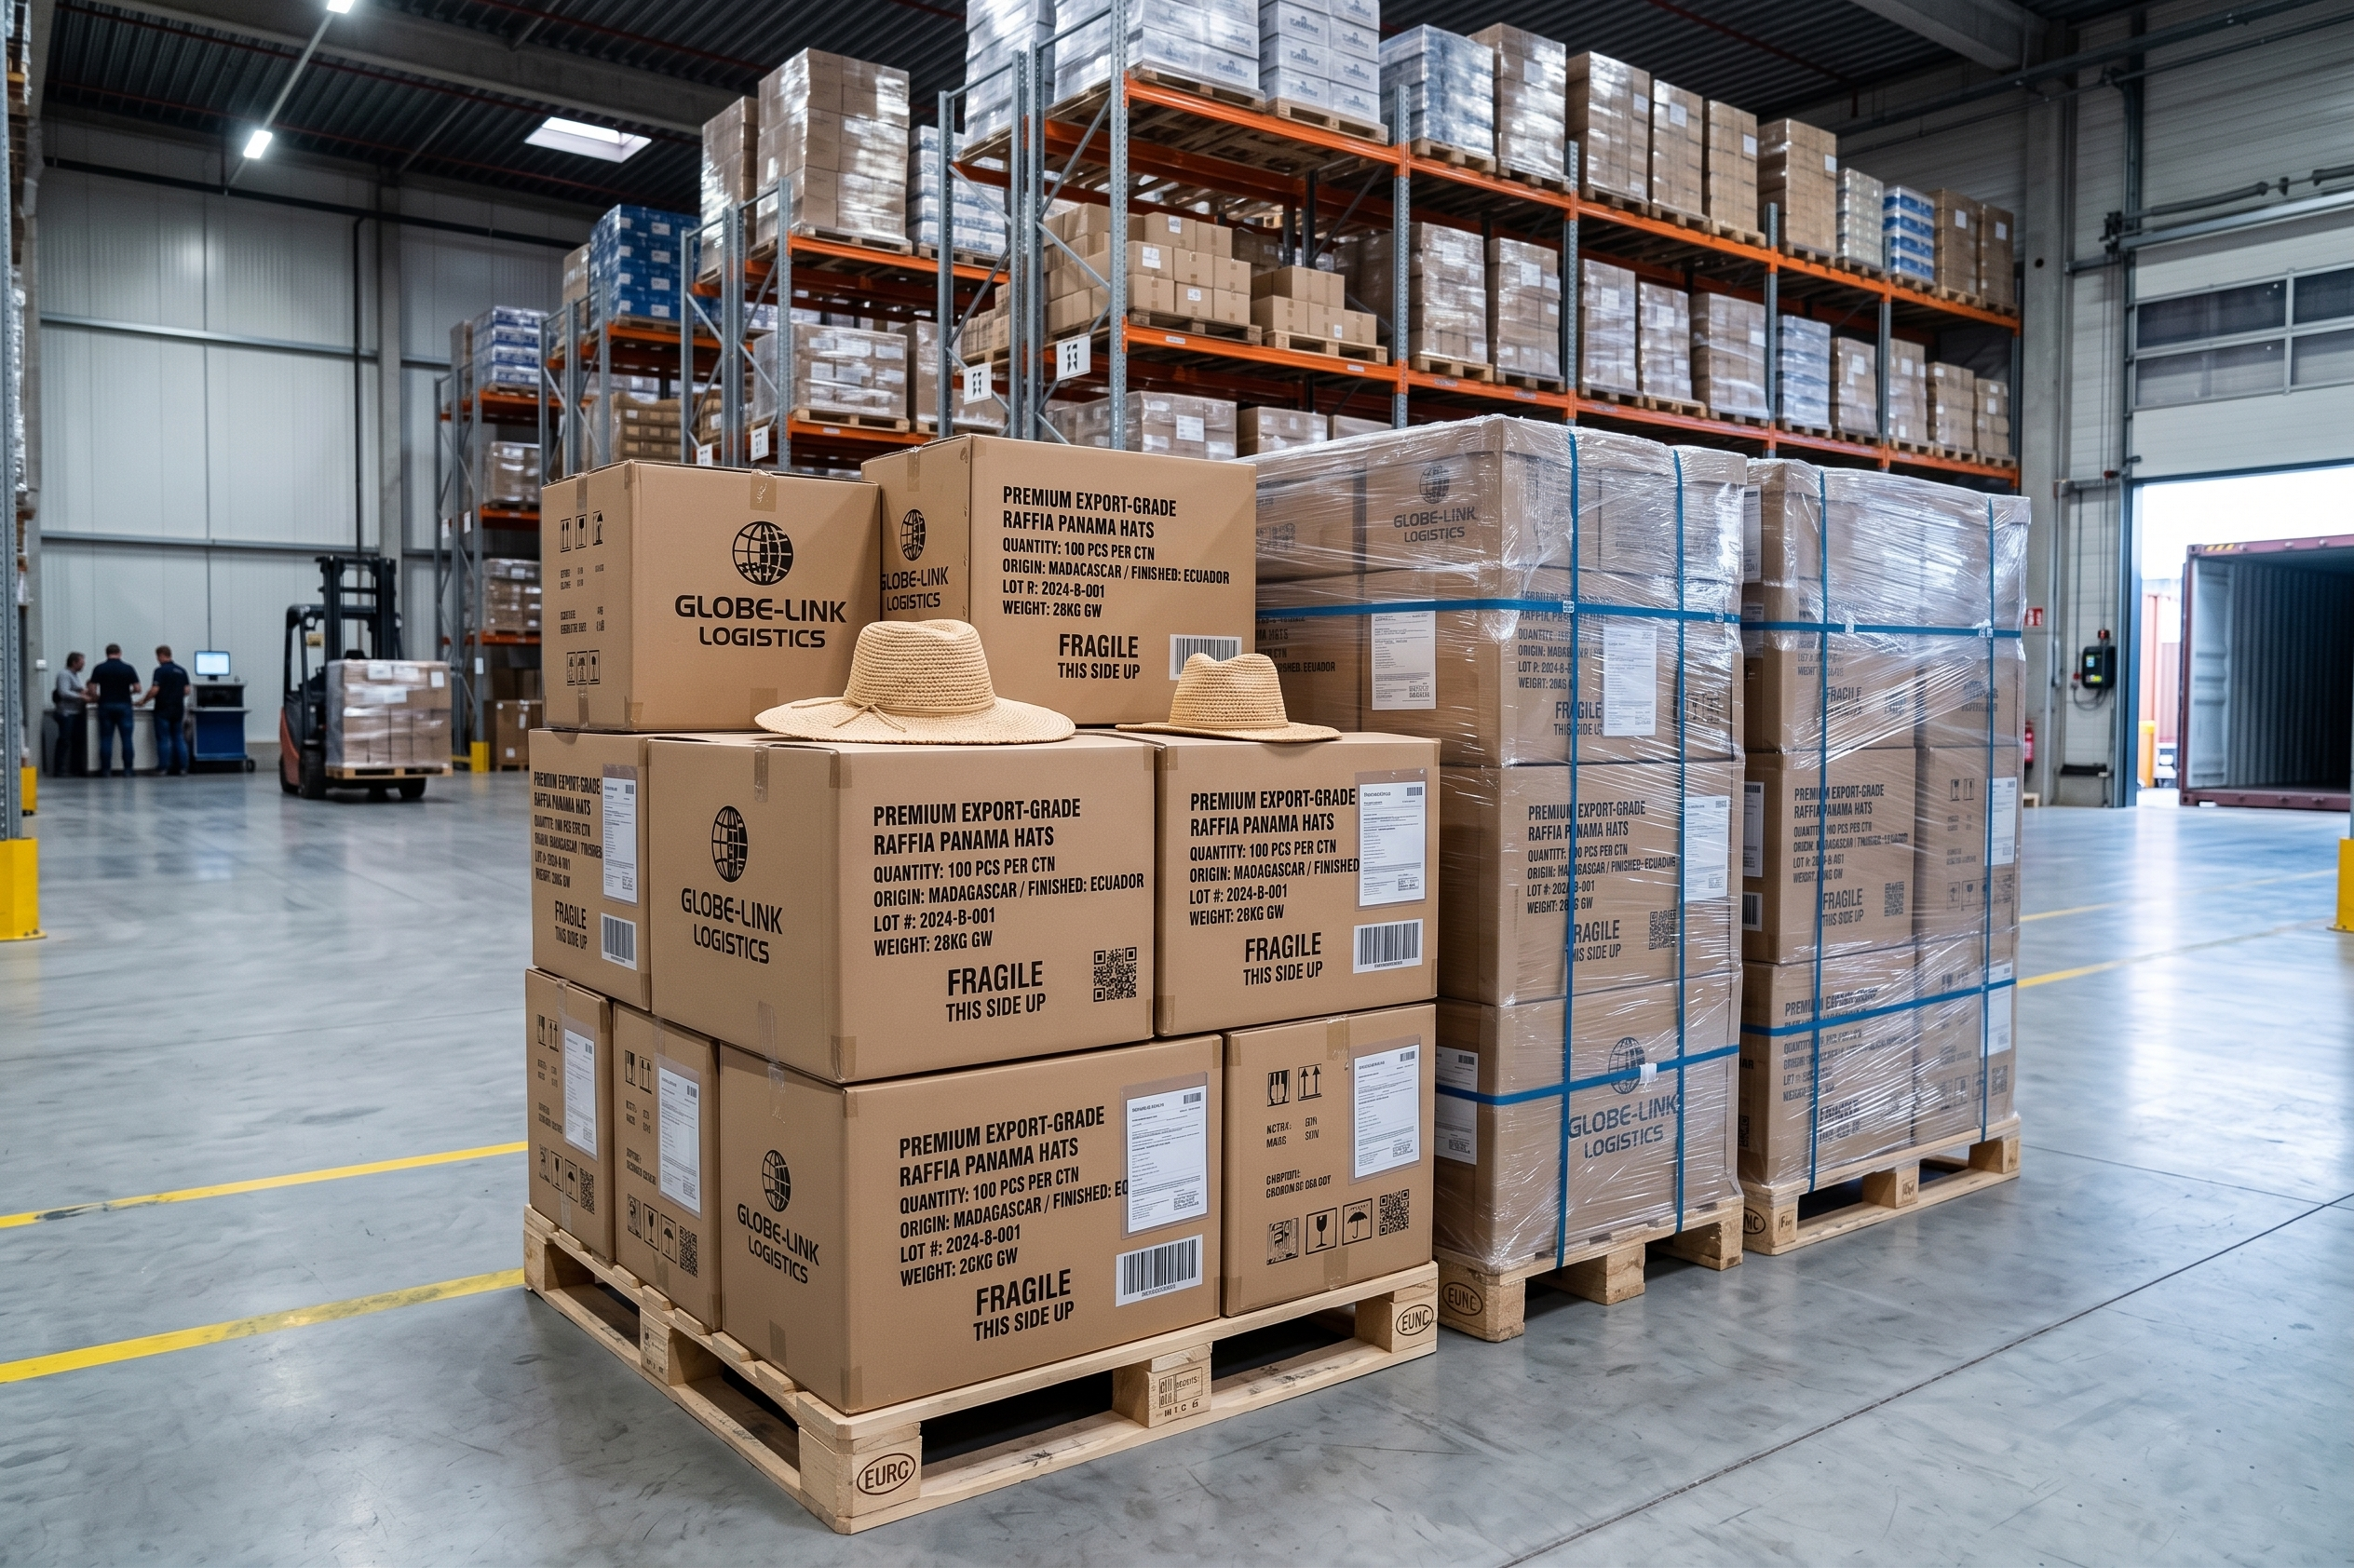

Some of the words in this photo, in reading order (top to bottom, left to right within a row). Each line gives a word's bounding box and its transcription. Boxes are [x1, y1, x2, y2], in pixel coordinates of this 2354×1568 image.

[1003, 486, 1071, 508] PREMIUM
[1076, 492, 1177, 518] EXPORT-GRADE
[1003, 510, 1054, 531] RAFFIA
[1059, 514, 1116, 536] PANAMA
[1120, 519, 1155, 538] HATS
[1393, 507, 1477, 528] GLOBE-LINK
[1404, 527, 1465, 542] LOGISTICS
[1003, 537, 1062, 555] QUANTITY:
[1064, 542, 1085, 556] 100
[1088, 543, 1108, 557] PCS
[1111, 545, 1131, 559] PER
[1134, 546, 1155, 561] CTN
[1002, 559, 1046, 574] ORIGIN:
[1131, 566, 1181, 581] FINISHED:
[1184, 569, 1230, 585] ECUADOR
[886, 592, 940, 611] LOGISTICS
[1003, 579, 1024, 594] LOT
[1041, 581, 1104, 598] 2024-B-001
[674, 595, 847, 623] GLOBE-LINK
[1002, 600, 1050, 616] WEIGHT:
[1052, 602, 1081, 616] 28KG
[1084, 603, 1103, 618] GW
[699, 627, 826, 648] LOGISTICS
[1059, 633, 1139, 658] FRAGILE
[1058, 662, 1088, 679] THIS
[1090, 663, 1119, 680] SIDE
[1123, 663, 1141, 680] UP
[873, 803, 956, 827] PREMIUM
[961, 798, 1081, 823] EXPORT-GRADE
[1190, 791, 1256, 811] PREMIUM
[1259, 788, 1356, 809] EXPORT-GRADE
[1577, 800, 1646, 818] EXPORT-GRADE
[1190, 817, 1239, 836] RAFFIA
[1242, 815, 1299, 834] PANAMA
[1302, 813, 1334, 831] HATS
[1529, 825, 1563, 842] RAFFIA
[1564, 823, 1603, 839] PNAMA
[1605, 821, 1629, 836] HATS
[873, 832, 935, 855] RAFFIA
[940, 829, 1009, 851] PANAMA
[1014, 826, 1054, 847] HATS
[1190, 844, 1246, 862] QUANTITY:
[1250, 844, 1268, 858] 100
[1272, 842, 1291, 857] PCS
[1294, 840, 1314, 855] PER
[1317, 839, 1336, 854] CTN
[1615, 844, 1628, 855] CTN
[873, 863, 944, 883] QUANTITY:
[948, 861, 972, 878] 100
[976, 858, 1000, 876] PCS
[1004, 857, 1028, 875] PER
[1032, 856, 1056, 873] CTN
[1190, 866, 1231, 883] ORIGIN:
[873, 888, 925, 907] ORIGIN:
[929, 882, 1017, 903] MADAGASCAR
[1028, 877, 1088, 896] FINISHED:
[1090, 873, 1144, 892] ECUADOR
[1190, 888, 1211, 905] LOT
[1213, 888, 1224, 903] #:
[1226, 883, 1287, 901] 2024-B-001
[1527, 885, 1542, 897] LOT
[555, 899, 587, 929] FRAGILE
[681, 887, 783, 935] GLOBE-LINK
[873, 914, 900, 932] LOT
[903, 913, 916, 929] #:
[920, 907, 994, 929] 2024-B-001
[1190, 909, 1234, 926] WEIGHT:
[1237, 905, 1265, 922] 28KG
[1266, 904, 1285, 920] GW
[693, 924, 770, 965] LOGISTICS
[873, 936, 930, 957] WEIGHT:
[934, 933, 967, 952] 28KG
[972, 930, 993, 948] GW
[1568, 920, 1620, 944] RAGILE
[1245, 931, 1322, 963] FRAGILE
[1587, 944, 1607, 961] SIDE
[1609, 944, 1622, 958] UP
[948, 961, 1043, 996] FRAGILE
[1243, 966, 1272, 986] THIS
[1275, 963, 1304, 982] SIDE
[1306, 961, 1323, 979] UP
[946, 1001, 981, 1022] THIS
[986, 995, 1021, 1019] SIDE
[1025, 993, 1047, 1013] UP
[1569, 1094, 1680, 1138] GLOBE-LINK
[900, 1127, 981, 1159] PREMIUM
[985, 1106, 1105, 1143] EXPORT-GRADE
[1585, 1124, 1664, 1158] LOGISTICS
[900, 1158, 961, 1188] RAFFIA
[965, 1145, 1035, 1175] PANAMA
[1039, 1138, 1078, 1162] HATS
[900, 1186, 969, 1214] QUANTITY:
[973, 1181, 996, 1201] 100
[1000, 1176, 1024, 1196] PCS
[1028, 1171, 1052, 1190] PER
[1056, 1166, 1078, 1185] CTN
[900, 1214, 950, 1238] ORIGIN:
[954, 1196, 1041, 1229] MADAGASCAR
[1053, 1183, 1112, 1209] FINISHED:
[737, 1203, 819, 1266] GLOBE-LINK
[749, 1235, 808, 1284] LOGISTICS
[900, 1242, 926, 1264] LOT
[930, 1240, 942, 1257] #:
[900, 1261, 955, 1287] WEIGHT:
[996, 1247, 1019, 1266] GW
[976, 1268, 1071, 1317] FRAGILE
[973, 1317, 1009, 1343] THIS
[1013, 1307, 1050, 1333] SIDE
[1053, 1300, 1075, 1322] UP
